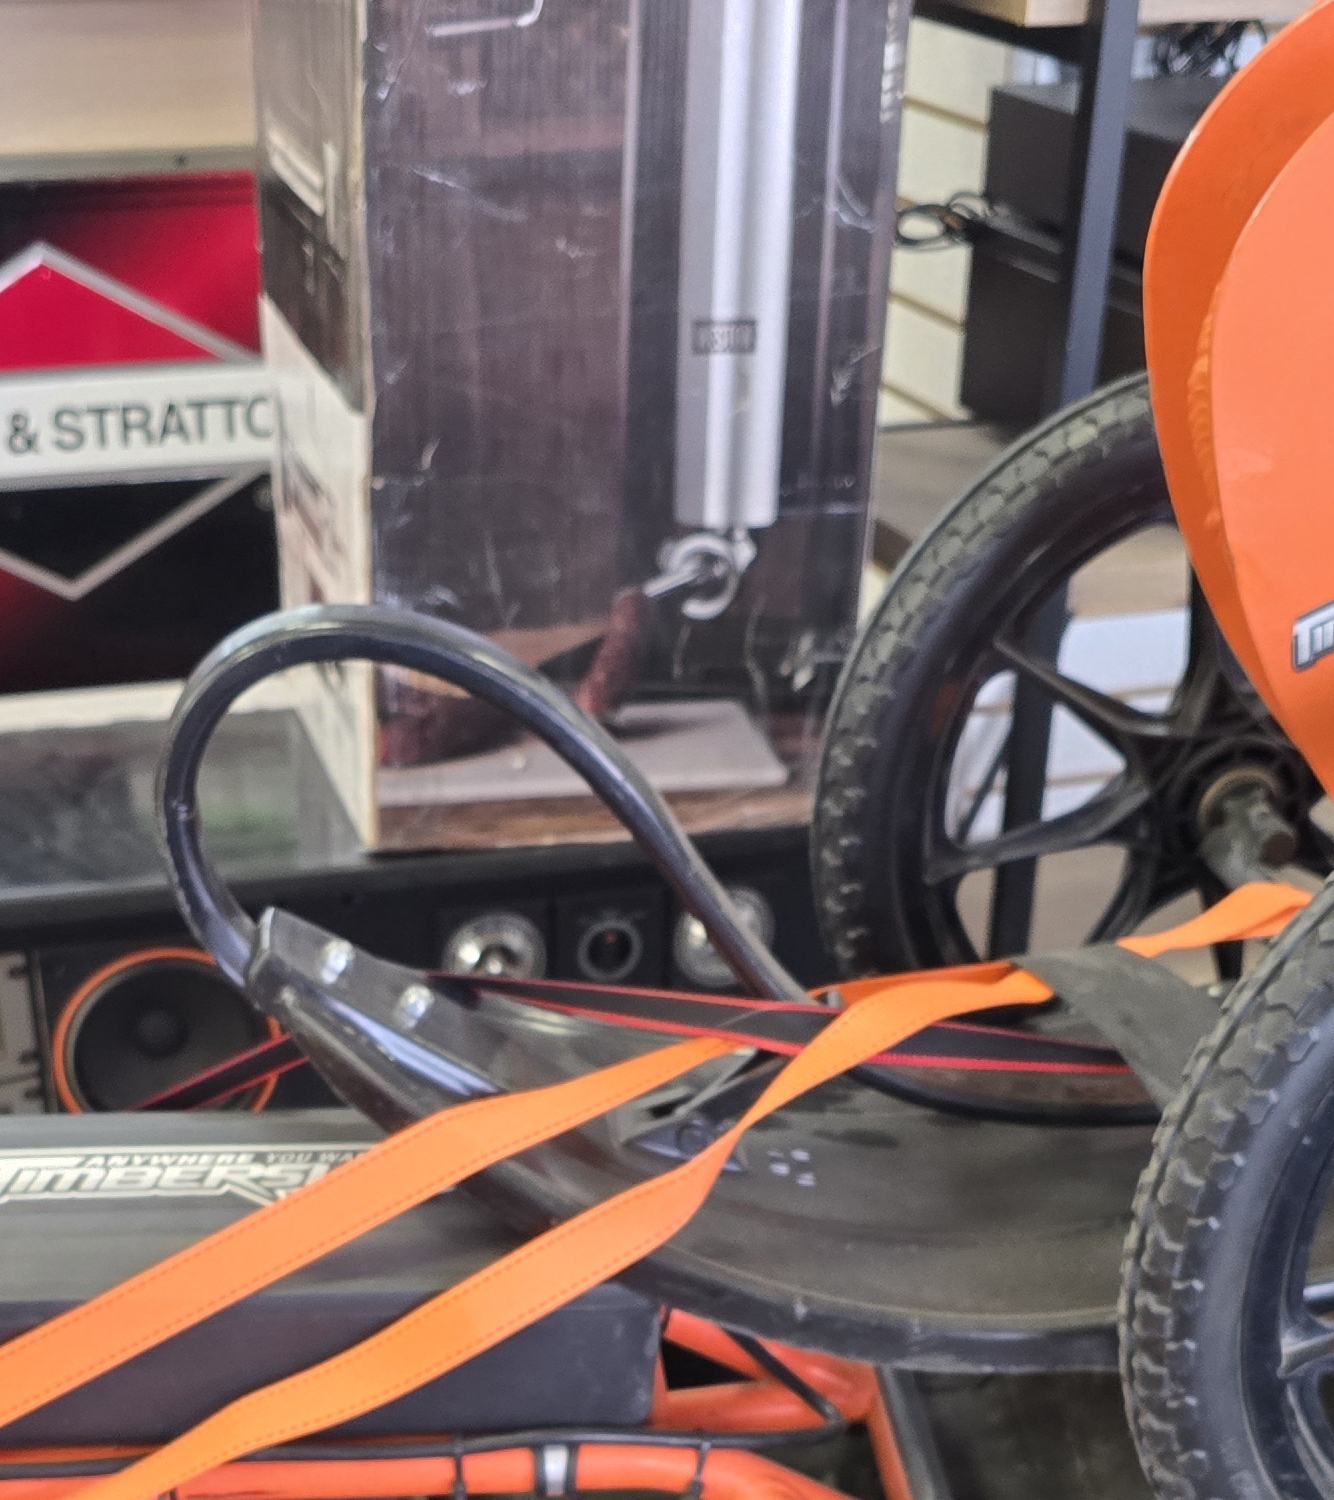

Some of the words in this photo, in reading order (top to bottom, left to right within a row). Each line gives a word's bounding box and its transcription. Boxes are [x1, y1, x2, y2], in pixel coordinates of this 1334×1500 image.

[8, 412, 38, 455] &
[84, 1151, 257, 1168] ANYWHERE
[267, 1151, 314, 1165] YOU
